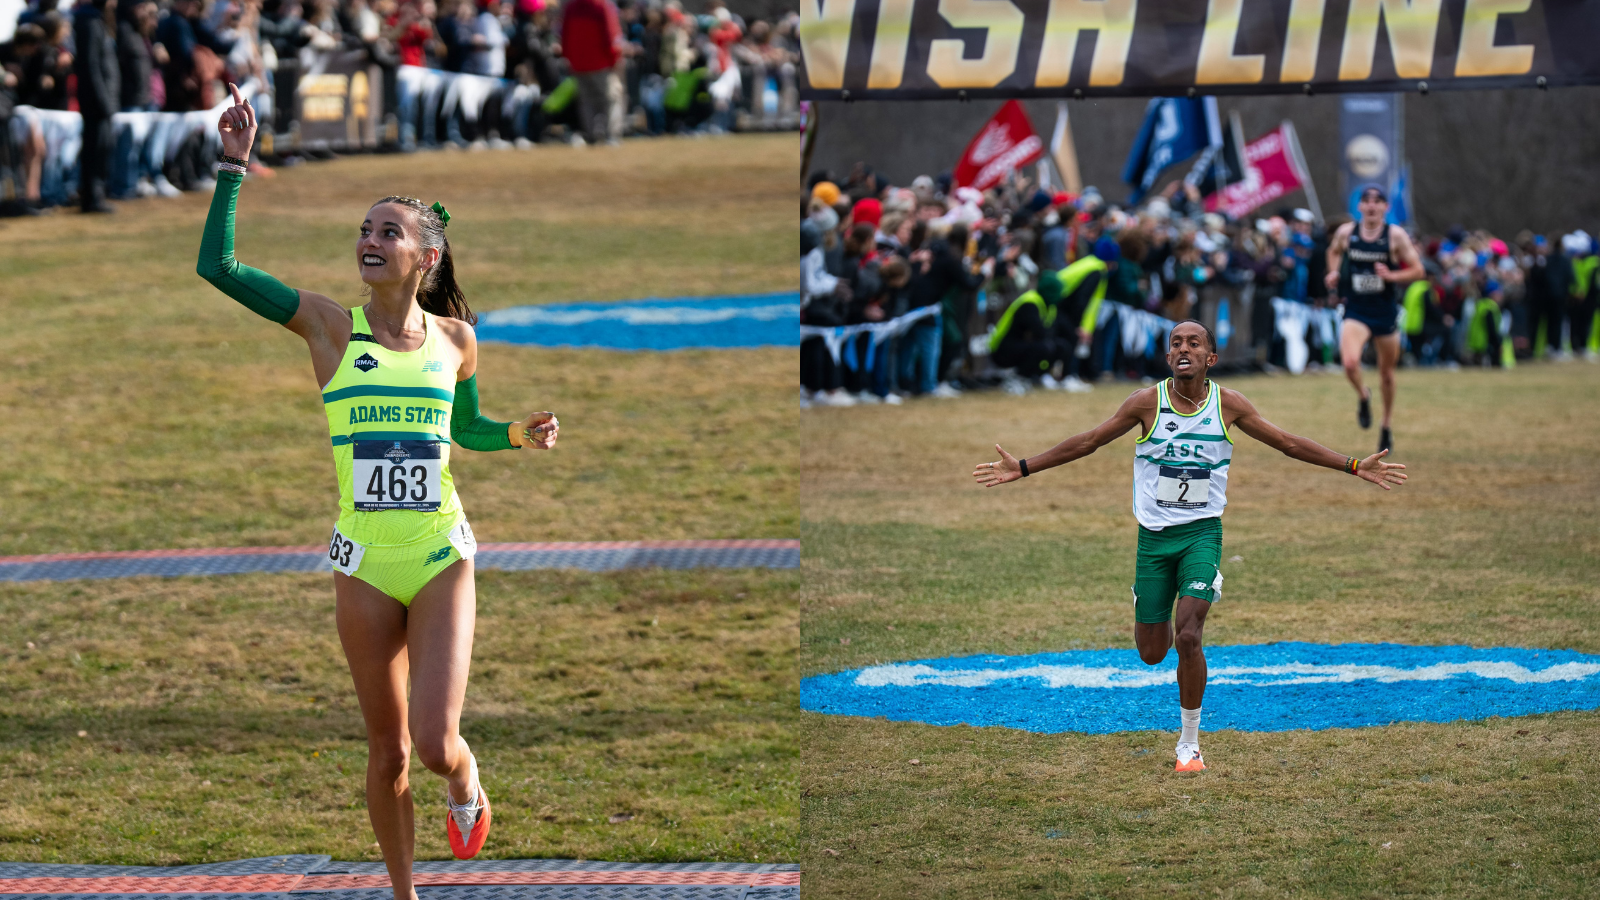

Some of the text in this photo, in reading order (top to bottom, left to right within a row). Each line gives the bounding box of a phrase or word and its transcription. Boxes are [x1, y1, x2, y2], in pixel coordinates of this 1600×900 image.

[1194, 0, 1536, 84] LINE
[356, 359, 377, 367] RMAC
[349, 405, 447, 428] ADAMS STATE
[1165, 442, 1204, 458] ASC
[366, 465, 428, 501] 463
[1177, 482, 1189, 502] 2
[329, 529, 354, 567] 63
